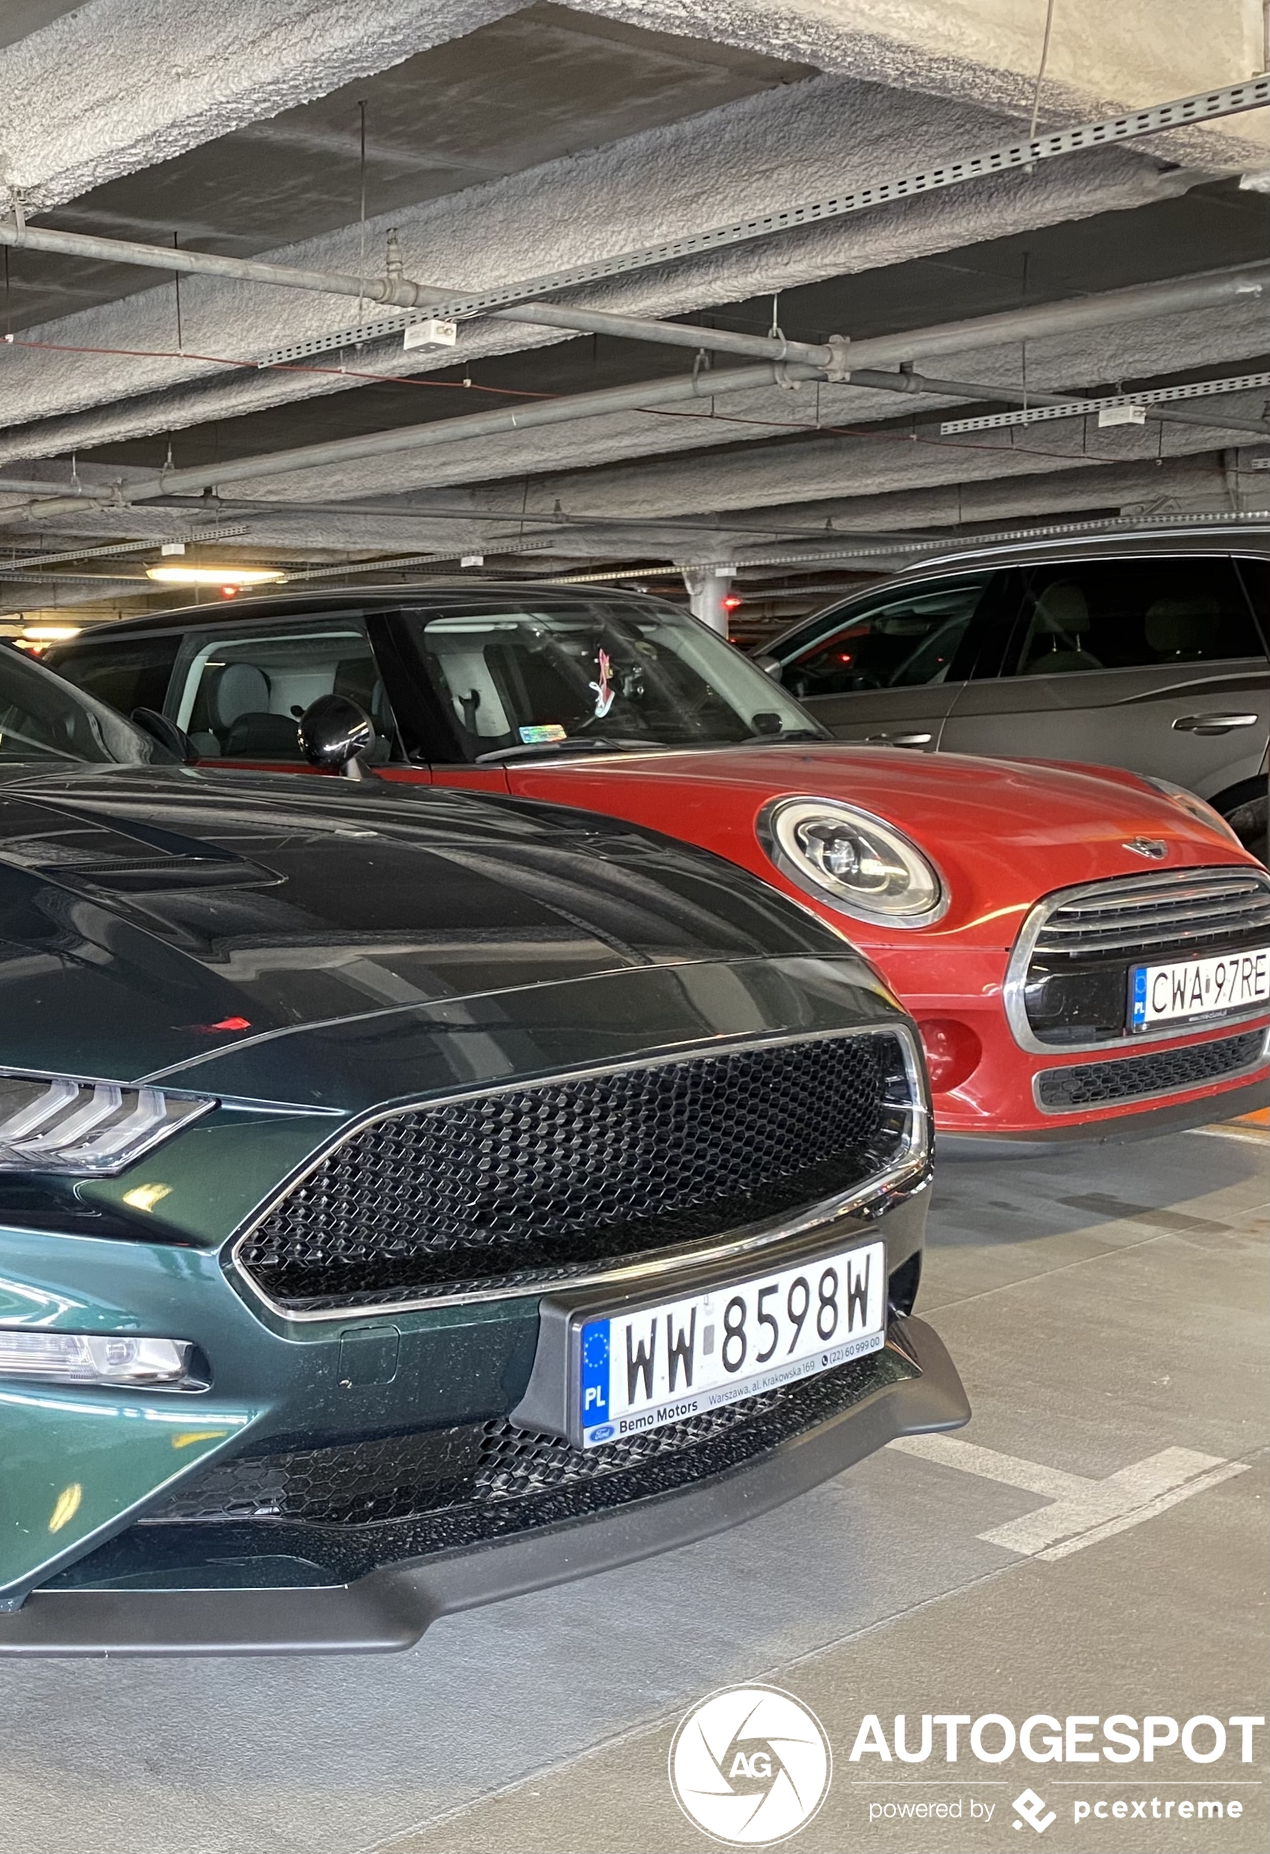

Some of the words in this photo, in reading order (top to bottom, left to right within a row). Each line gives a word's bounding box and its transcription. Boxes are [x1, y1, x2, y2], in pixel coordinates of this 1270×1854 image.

[1134, 1001, 1145, 1015] PL
[1152, 966, 1204, 1013] CWA
[1214, 954, 1267, 1006] 97RE
[625, 1306, 697, 1406] WW
[721, 1253, 871, 1373] 8598W
[584, 1385, 606, 1411] PL
[619, 1414, 654, 1433] Bemo
[656, 1400, 698, 1423] Motors
[708, 1383, 751, 1405] Warszawa,
[752, 1379, 762, 1391] al.
[762, 1364, 802, 1387] Krakowska
[802, 1360, 815, 1375] 169
[829, 1350, 844, 1365] (22)
[845, 1346, 855, 1358] 60
[855, 1341, 869, 1355] 999
[870, 1336, 880, 1348] 00
